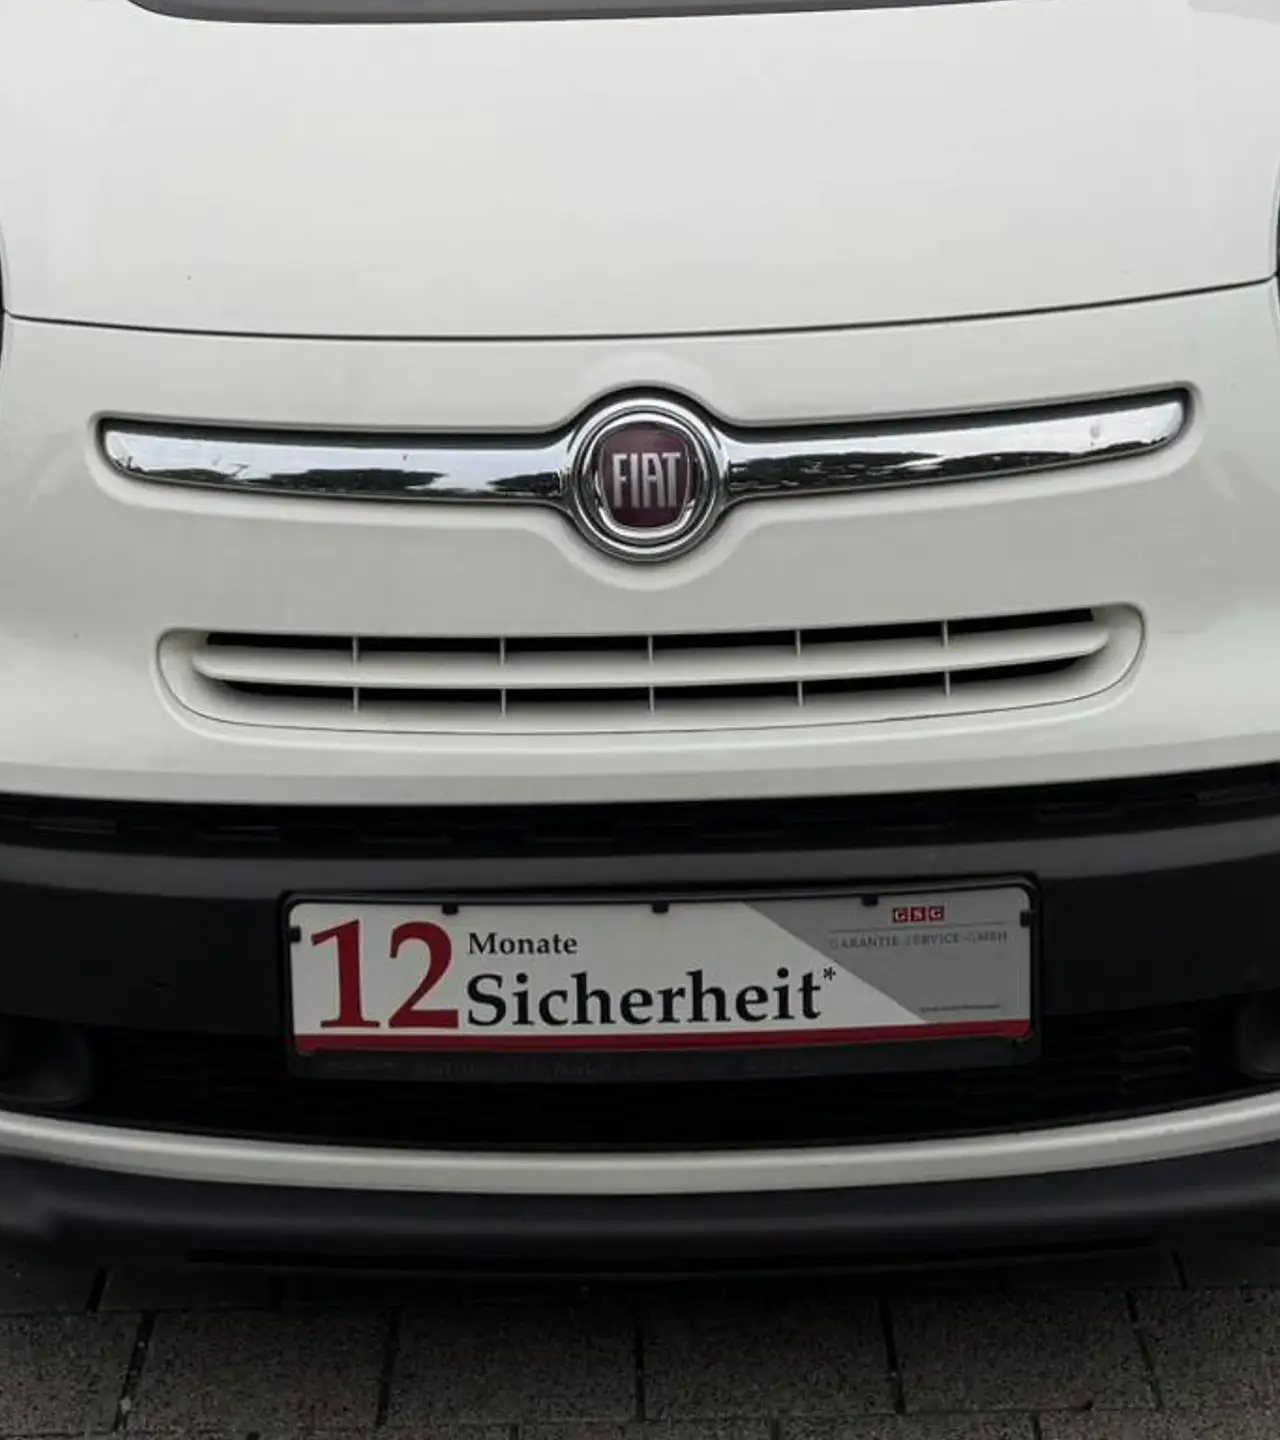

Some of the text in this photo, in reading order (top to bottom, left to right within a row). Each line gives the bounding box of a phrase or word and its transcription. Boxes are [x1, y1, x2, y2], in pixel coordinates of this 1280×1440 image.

[611, 452, 681, 509] FIAT
[467, 930, 578, 956] Monate
[310, 918, 460, 1030] 12
